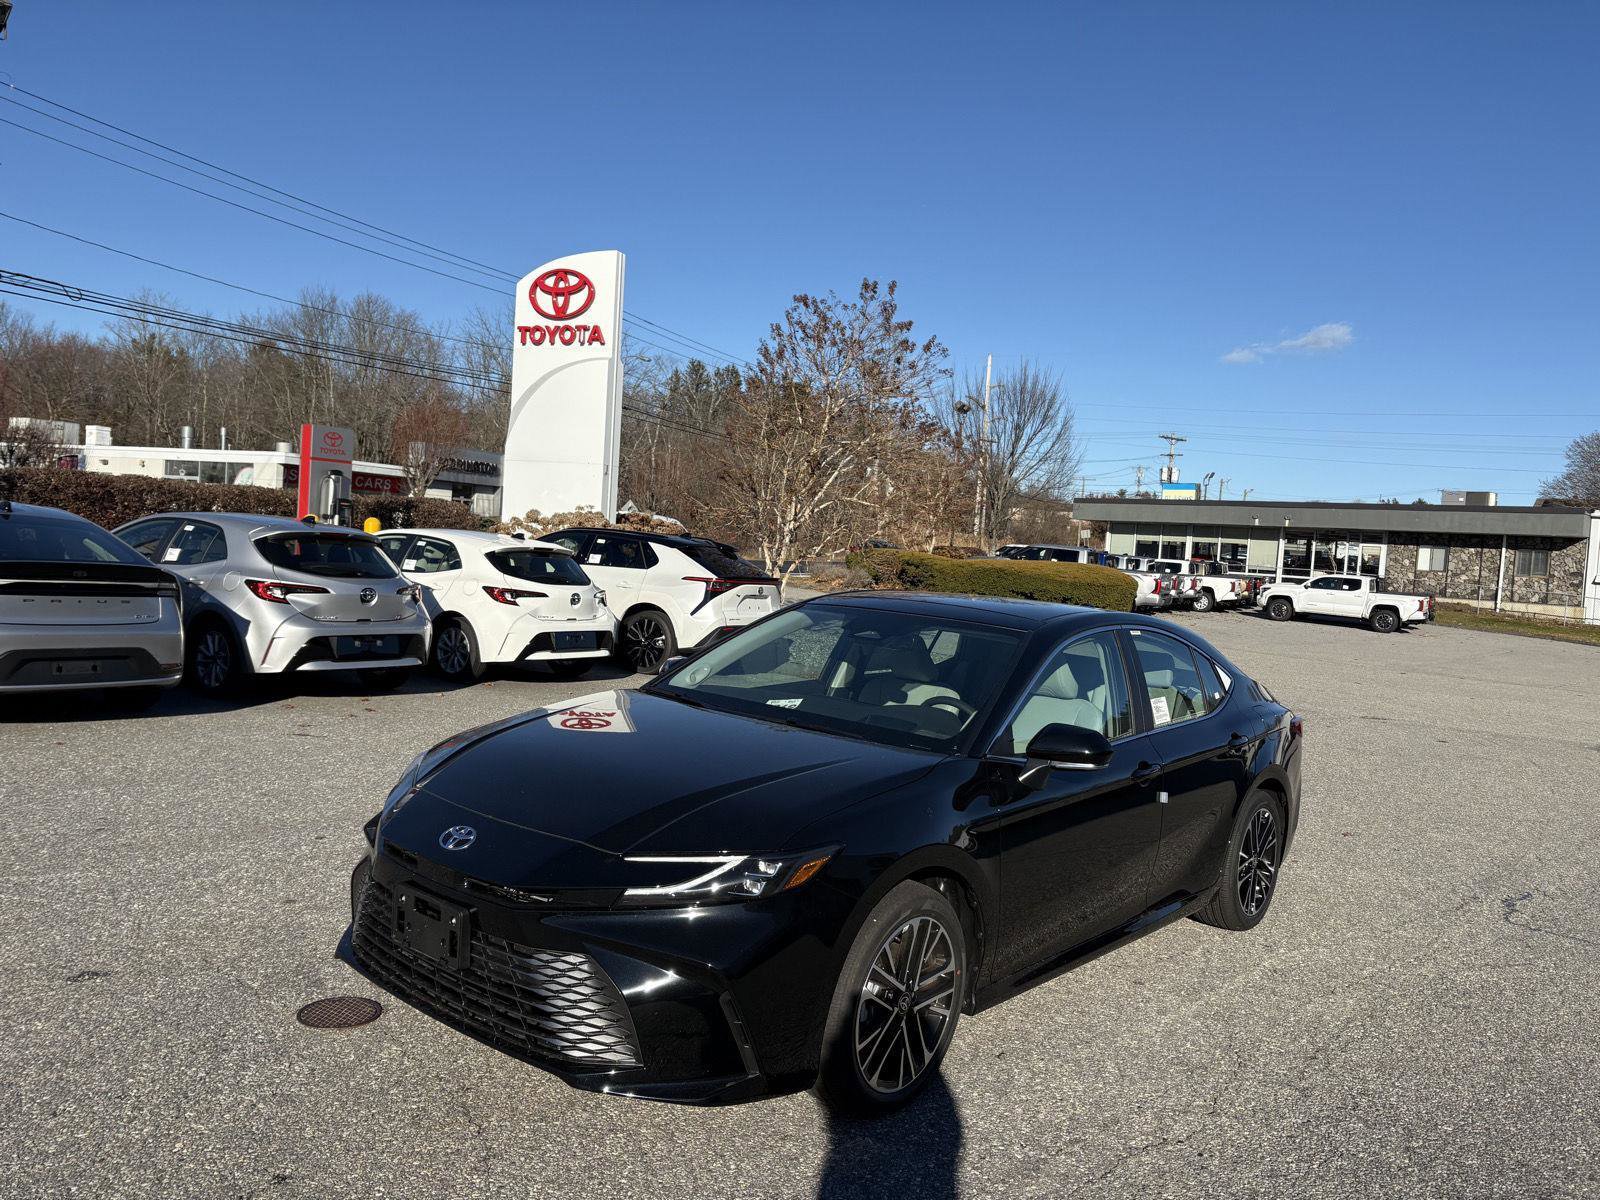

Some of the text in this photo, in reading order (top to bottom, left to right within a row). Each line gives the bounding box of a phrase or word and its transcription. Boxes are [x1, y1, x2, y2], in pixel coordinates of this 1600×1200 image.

[517, 325, 605, 346] TOYOTA
[320, 447, 346, 455] TOYOTA
[355, 476, 391, 490] CARS
